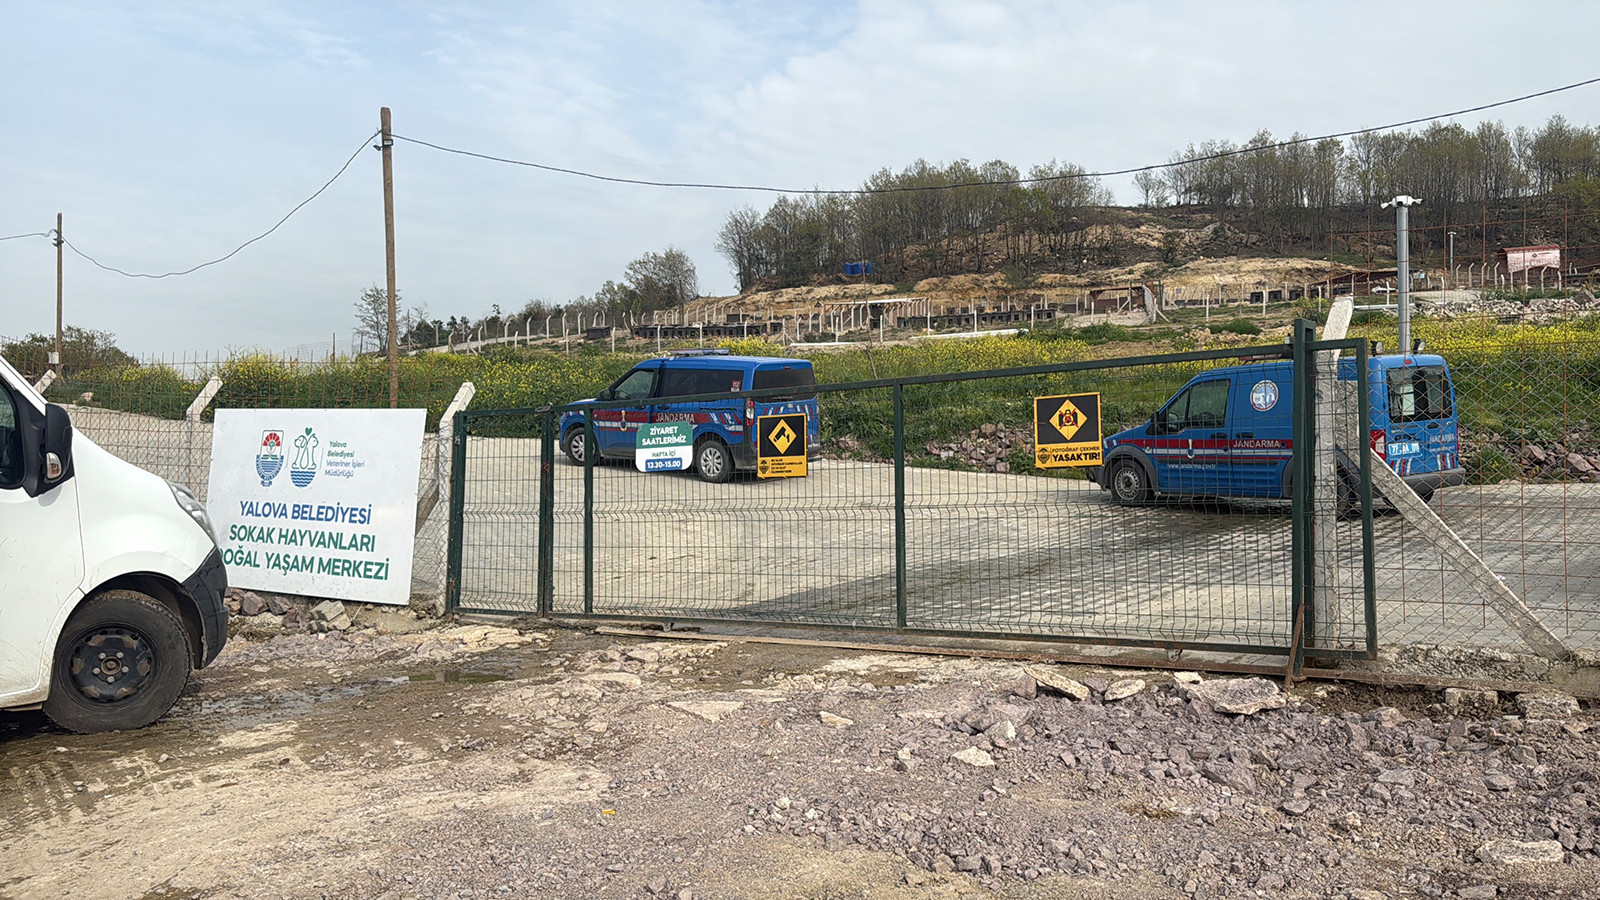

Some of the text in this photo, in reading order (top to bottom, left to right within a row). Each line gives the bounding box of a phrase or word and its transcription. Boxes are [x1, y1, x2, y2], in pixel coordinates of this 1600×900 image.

[655, 413, 695, 423] JANDARMA
[649, 425, 679, 436] ZİYARET
[329, 440, 347, 448] Yalova
[641, 433, 687, 446] SAATLERİMİZ
[1233, 440, 1280, 448] JANDARMA
[327, 450, 355, 459] Belediyesi
[1052, 452, 1101, 462] YASAKTIR!
[326, 459, 351, 468] Veteriner
[647, 460, 681, 469] 13.30-15.00
[324, 470, 354, 479] Müdürlüğü
[240, 500, 372, 525] YALOVA BELEDİYESİ
[229, 524, 376, 552] SOKAK HAYVANLARI
[218, 545, 390, 581] OĞAL YAŞAM MERKEZİ
